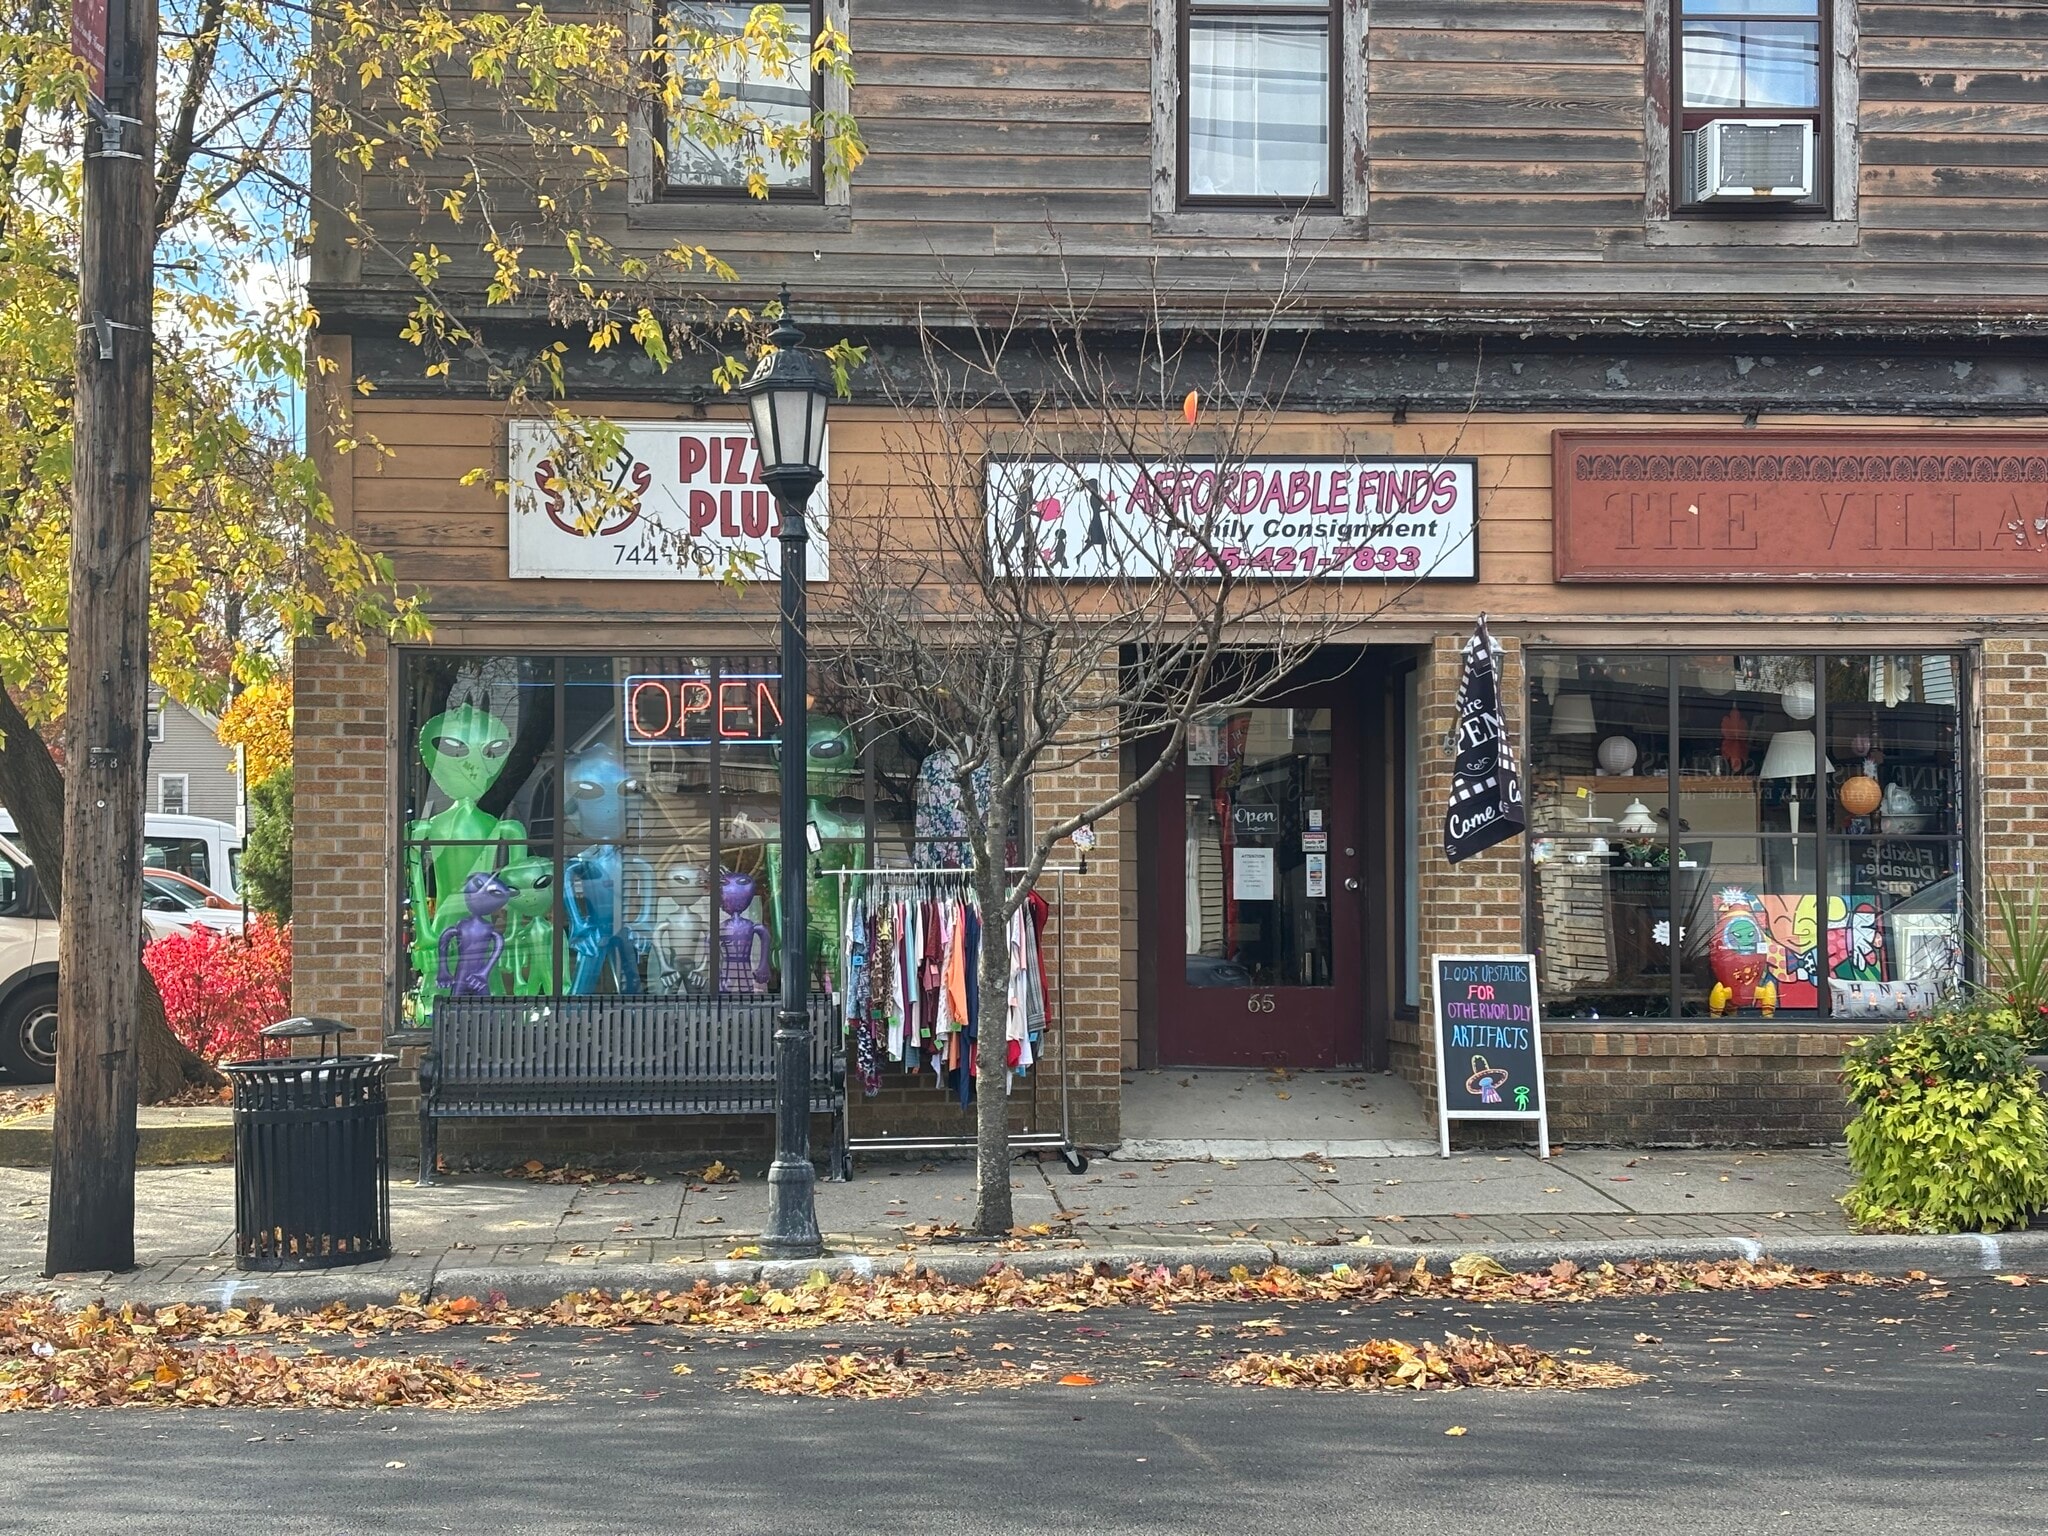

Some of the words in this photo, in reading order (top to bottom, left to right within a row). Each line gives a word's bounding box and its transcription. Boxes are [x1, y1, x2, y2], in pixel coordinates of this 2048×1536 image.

[1125, 470, 1349, 515] AFFORDABLE
[1355, 470, 1458, 515] FINDS
[1263, 519, 1438, 542] Consignment
[1605, 492, 1758, 551] THE
[1804, 492, 2048, 552] VILLA
[1234, 808, 1277, 827] Open
[1450, 805, 1496, 839] Come
[1443, 965, 1478, 982] LOOK
[1481, 965, 1528, 983] UPSTAIRS
[1247, 993, 1275, 1013] 65
[1467, 984, 1495, 1001] FOR
[1447, 1002, 1532, 1022] OTHERWORLDLY
[1451, 1024, 1529, 1050] ARTIFACTS
